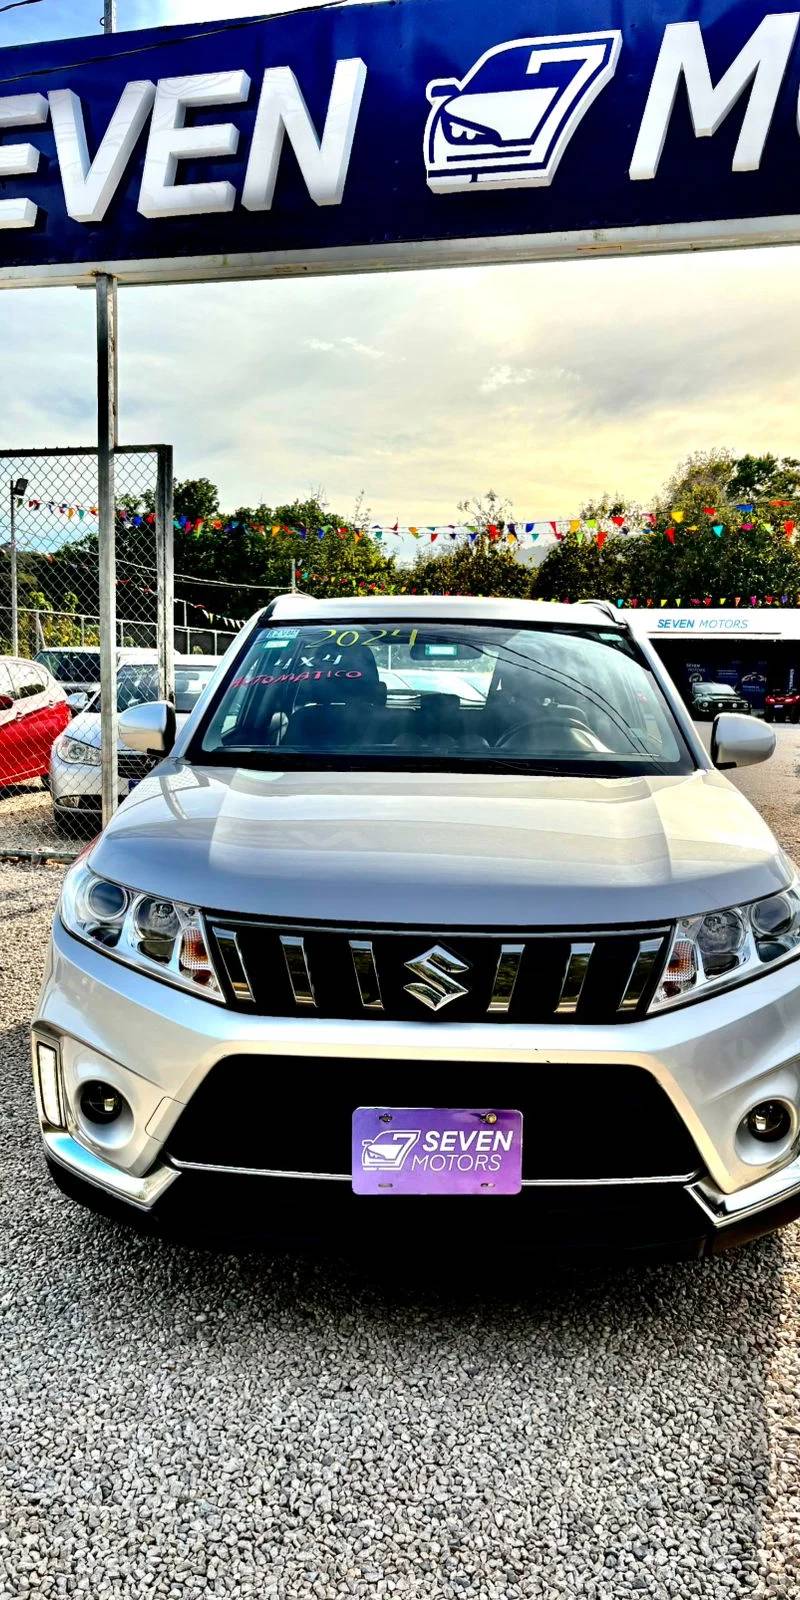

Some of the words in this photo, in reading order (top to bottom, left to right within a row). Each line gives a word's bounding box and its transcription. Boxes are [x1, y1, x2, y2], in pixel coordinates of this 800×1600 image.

[628, 12, 800, 181] M
[657, 618, 695, 629] SEVEN
[699, 619, 749, 629] MOTORS
[305, 628, 419, 649] 2024
[423, 1130, 514, 1152] SEVEN
[411, 1154, 502, 1172] MOTORS
